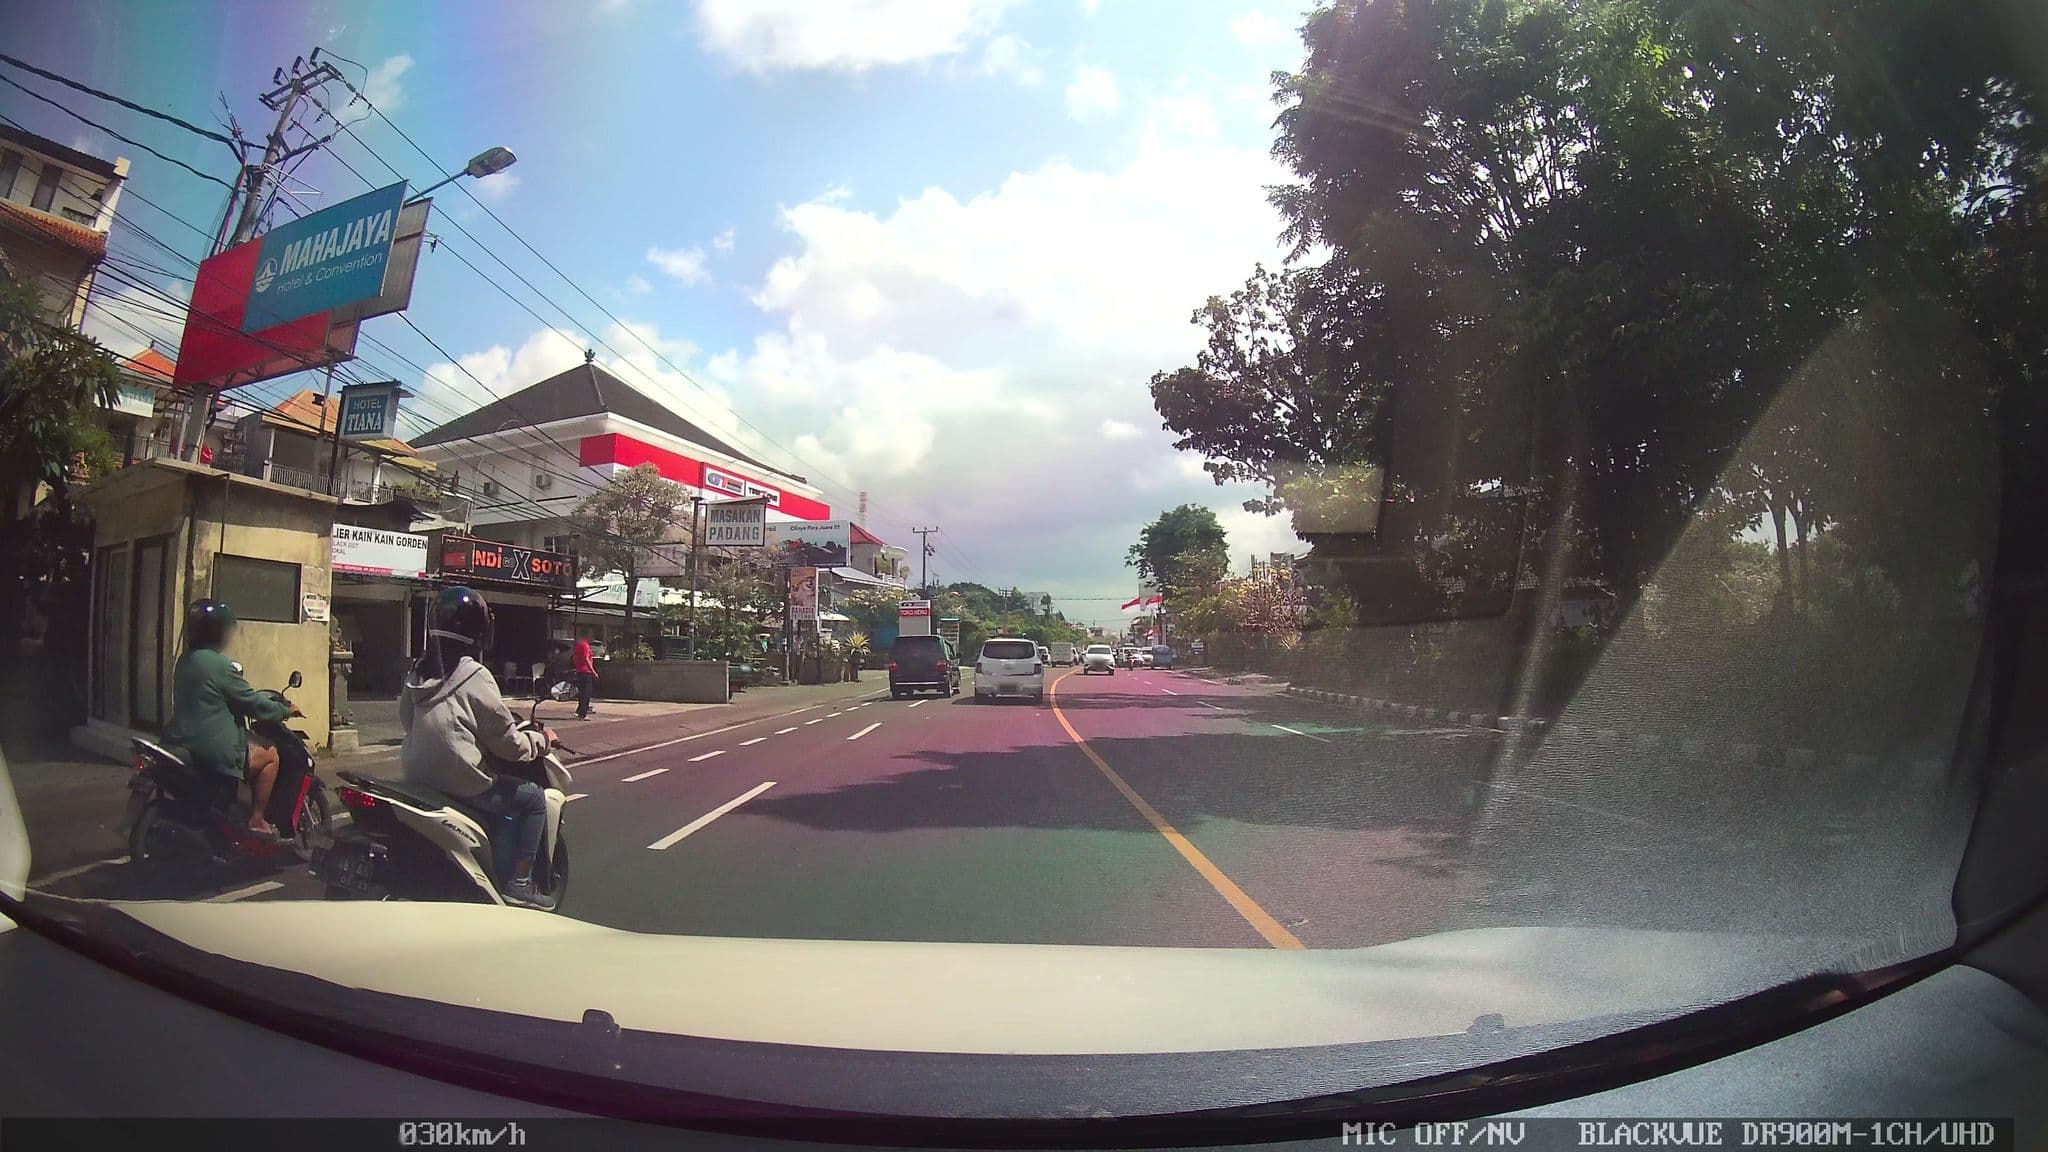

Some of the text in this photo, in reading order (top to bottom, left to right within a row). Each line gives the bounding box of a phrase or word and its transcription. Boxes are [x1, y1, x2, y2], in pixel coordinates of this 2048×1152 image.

[280, 209, 392, 276] MAHAJAYA
[277, 252, 383, 293] Hotel & Convention
[353, 399, 382, 410] HOTEL
[347, 412, 382, 431] TIANA
[710, 509, 761, 523] MASAKAN
[352, 529, 373, 543] KAIN
[374, 532, 394, 546] KAIN
[396, 536, 428, 550] GORDEN
[709, 527, 760, 541] PADANG
[532, 558, 573, 577] SOTO
